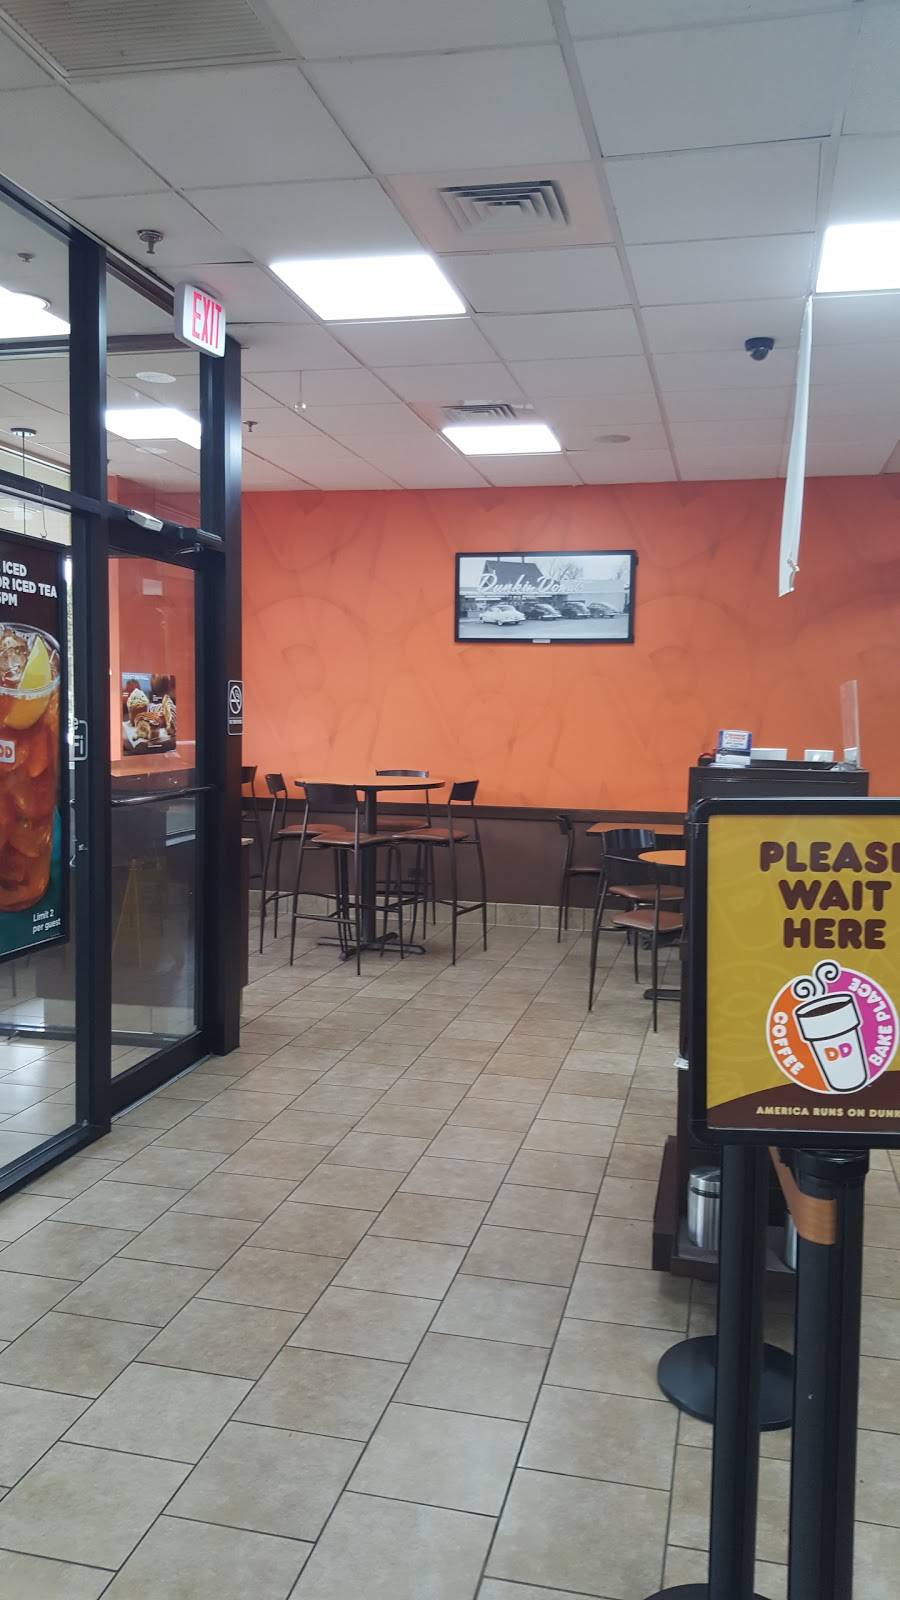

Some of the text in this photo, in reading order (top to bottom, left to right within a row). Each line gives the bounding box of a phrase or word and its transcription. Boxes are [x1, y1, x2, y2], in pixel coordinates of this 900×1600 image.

[192, 291, 222, 349] EXIT
[2, 560, 28, 577] ICED
[12, 578, 37, 594] ICED
[38, 583, 58, 599] TEA
[778, 880, 892, 911] WAIT
[33, 908, 55, 922] Limit 2
[32, 918, 61, 935] per guest
[783, 917, 887, 950] HERE
[847, 977, 893, 1067] BAKE PLACE
[772, 1011, 805, 1076] COFFEE
[823, 1042, 853, 1062] DD
[756, 1105, 810, 1116] AMERICA
[812, 1107, 844, 1117] RUNS
[846, 1108, 866, 1118] ON
